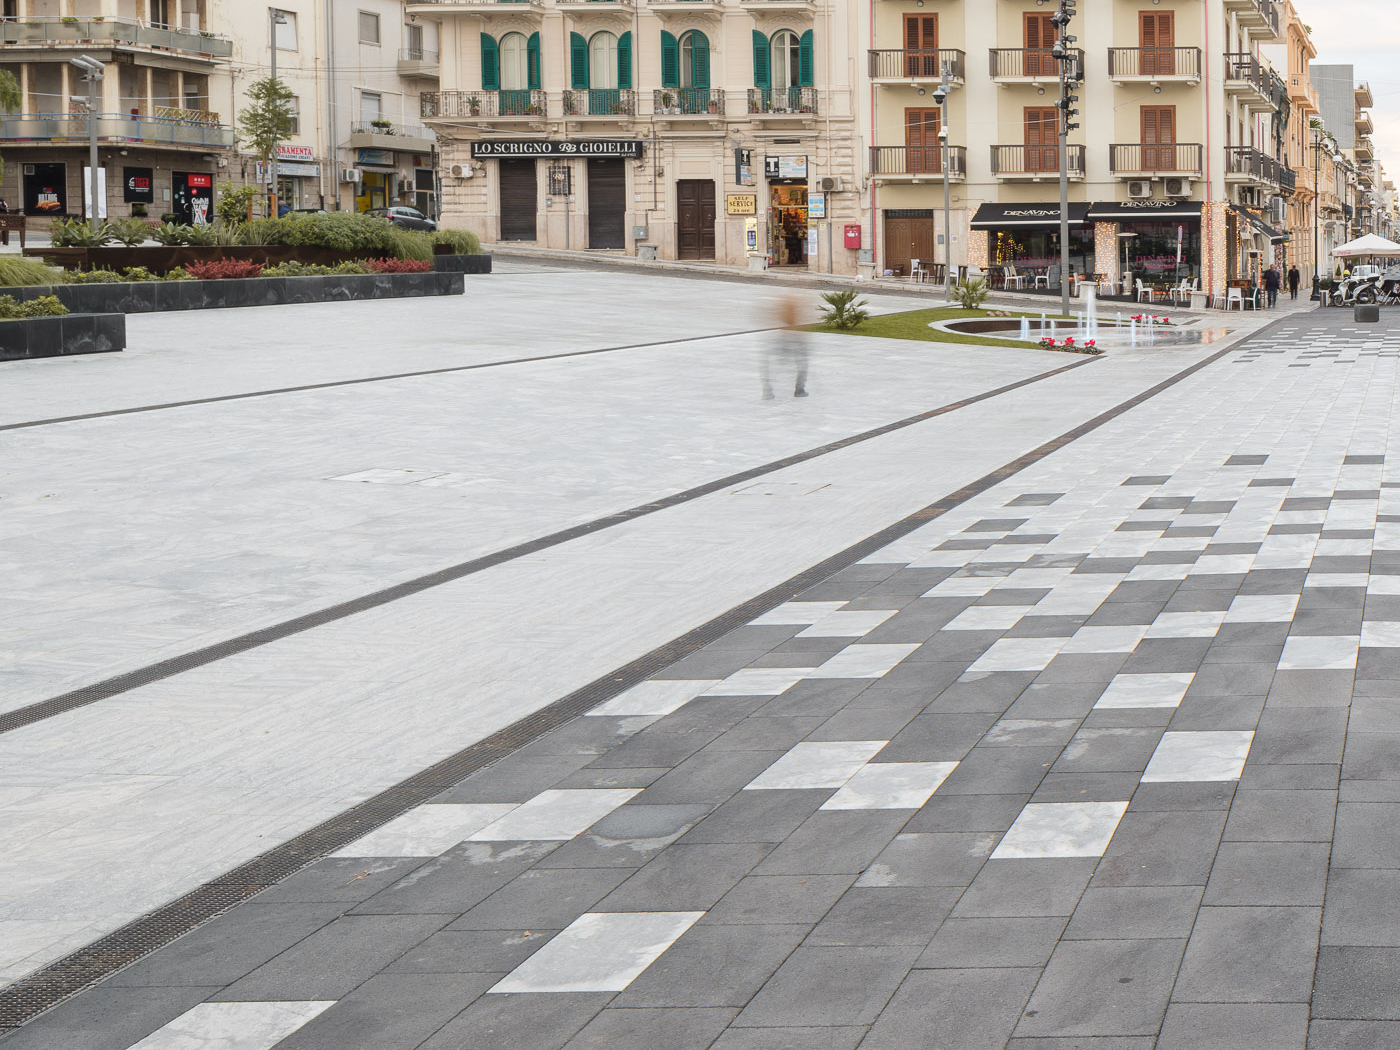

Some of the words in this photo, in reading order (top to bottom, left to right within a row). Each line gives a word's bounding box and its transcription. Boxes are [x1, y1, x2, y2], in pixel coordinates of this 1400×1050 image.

[474, 143, 491, 154] LO
[493, 142, 552, 154] SCRIGNO
[579, 142, 637, 153] GIOIELLI
